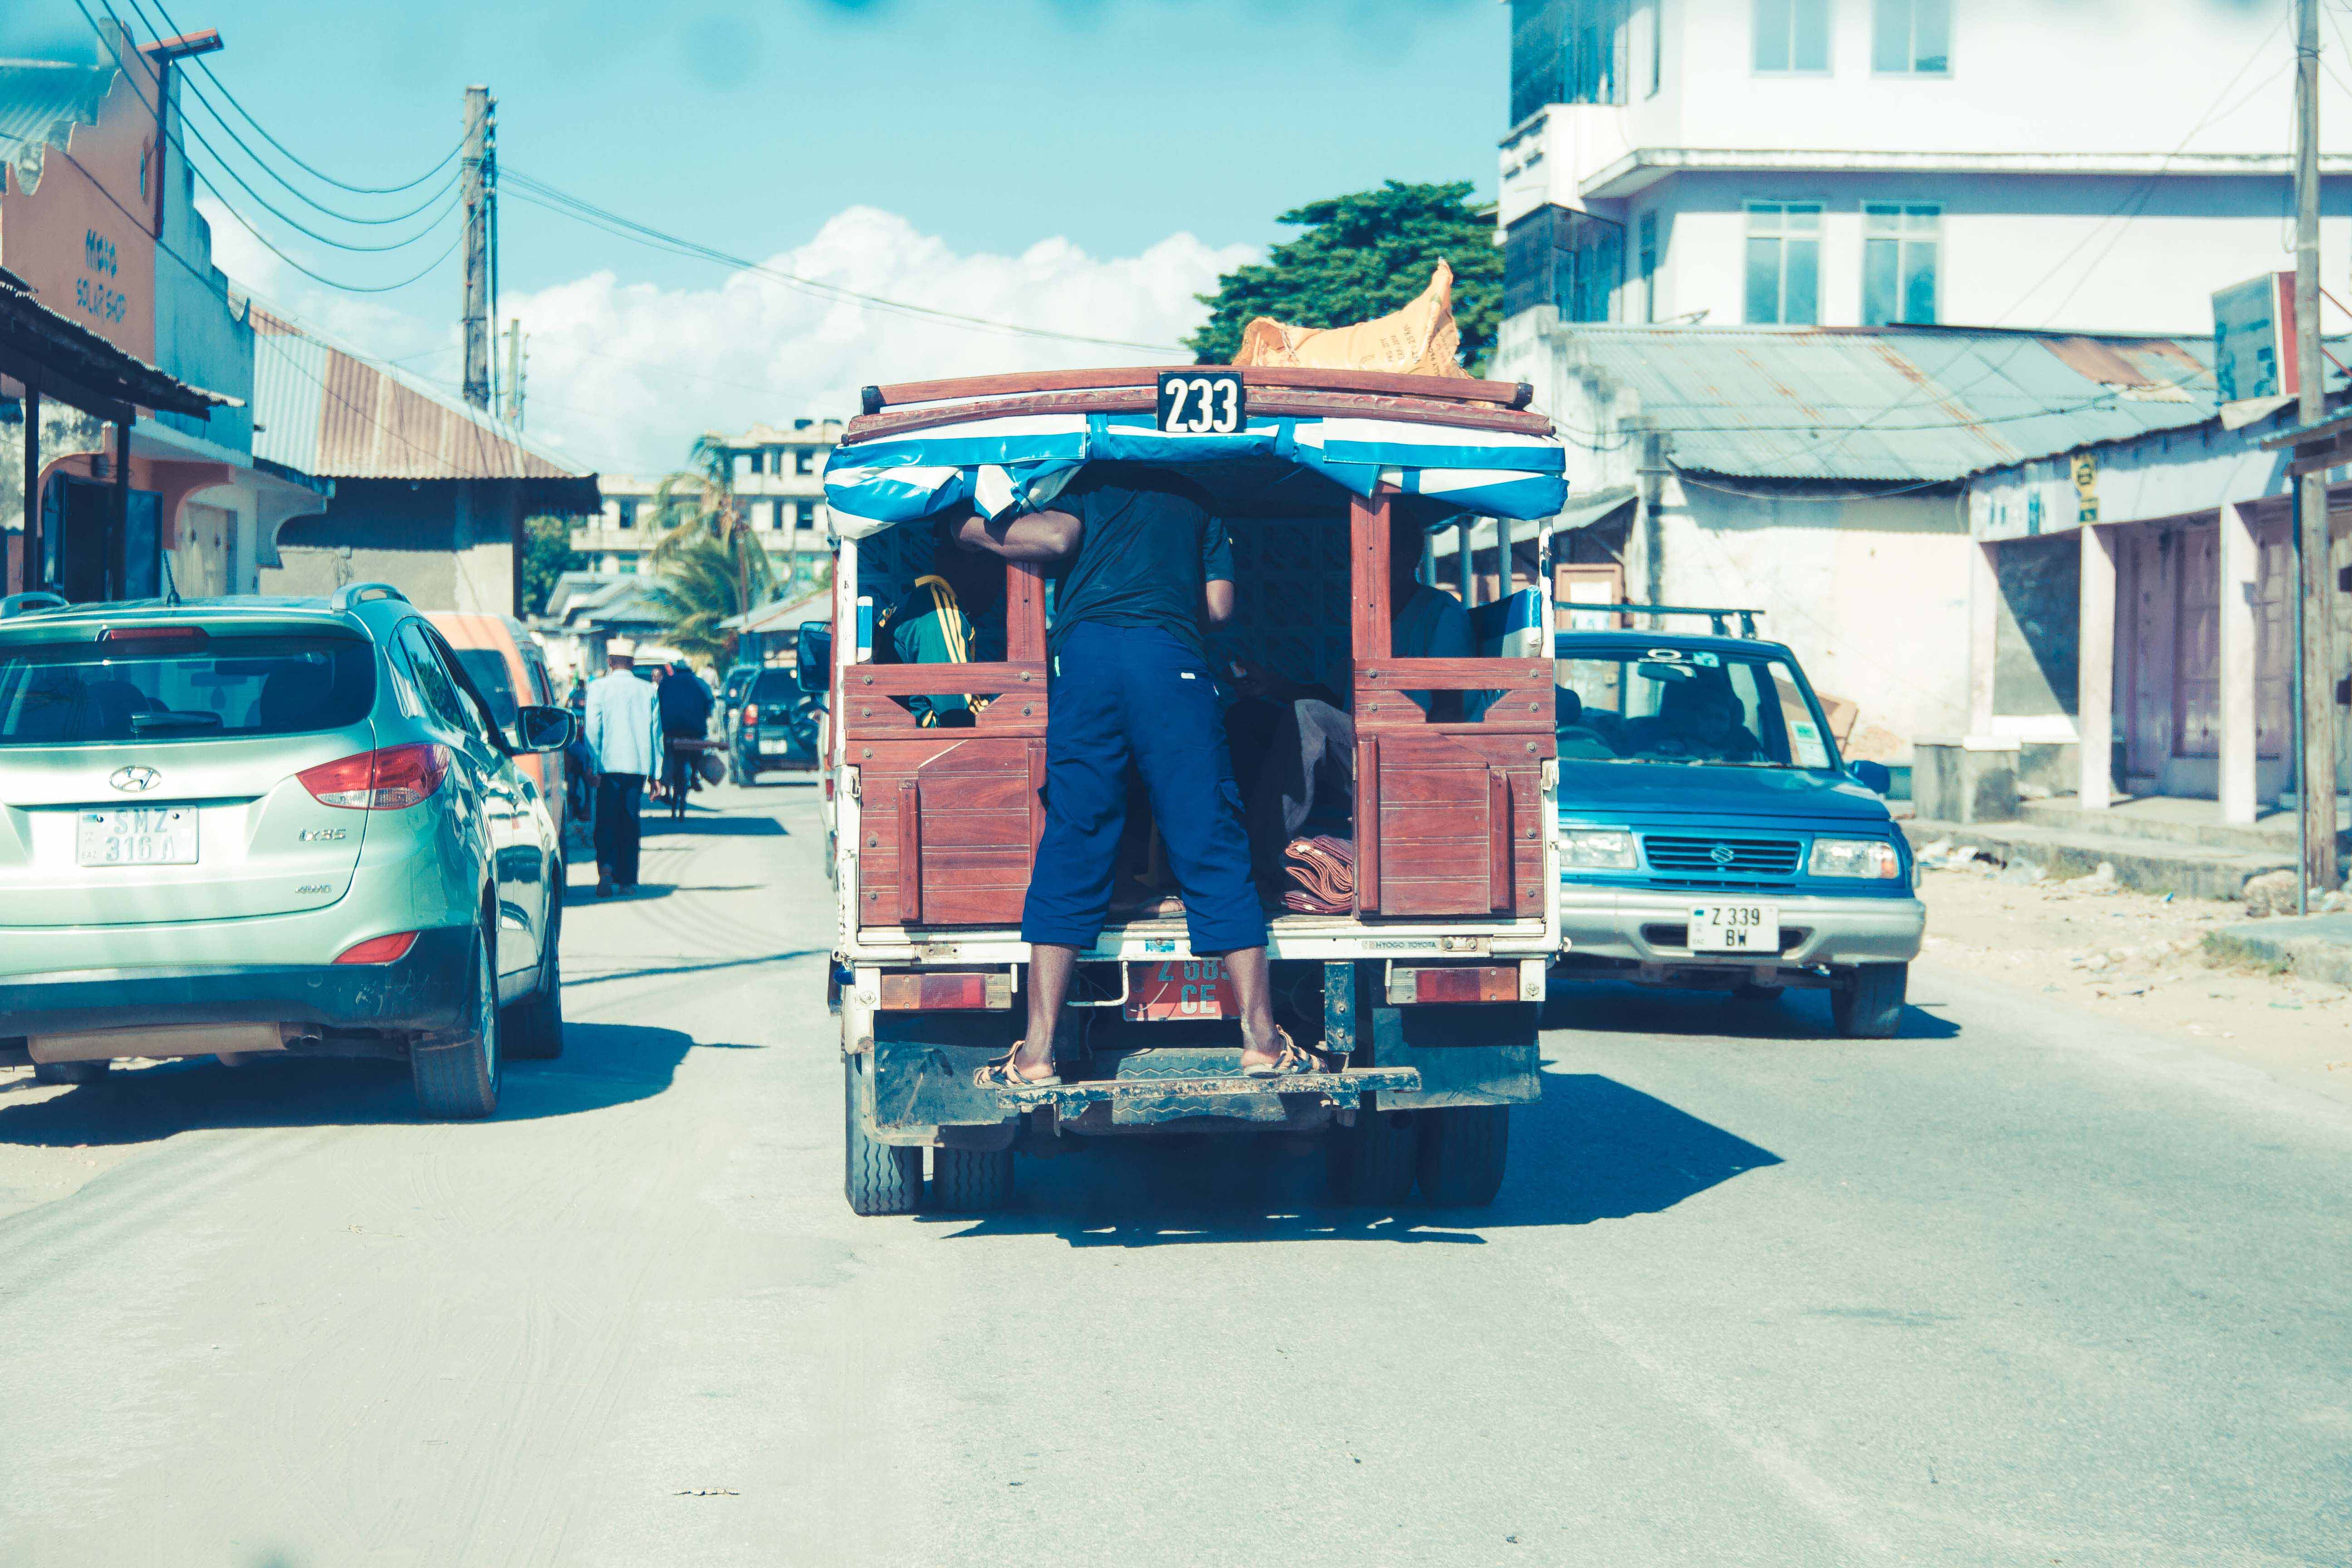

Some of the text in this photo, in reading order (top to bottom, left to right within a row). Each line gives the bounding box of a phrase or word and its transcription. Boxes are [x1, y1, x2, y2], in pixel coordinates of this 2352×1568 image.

[1166, 378, 1237, 432] 233
[114, 808, 167, 834] SMZ
[1712, 908, 1760, 926] Z 339
[1727, 929, 1747, 947] BW
[1158, 960, 1175, 981] Z
[1181, 984, 1216, 1014] CE
